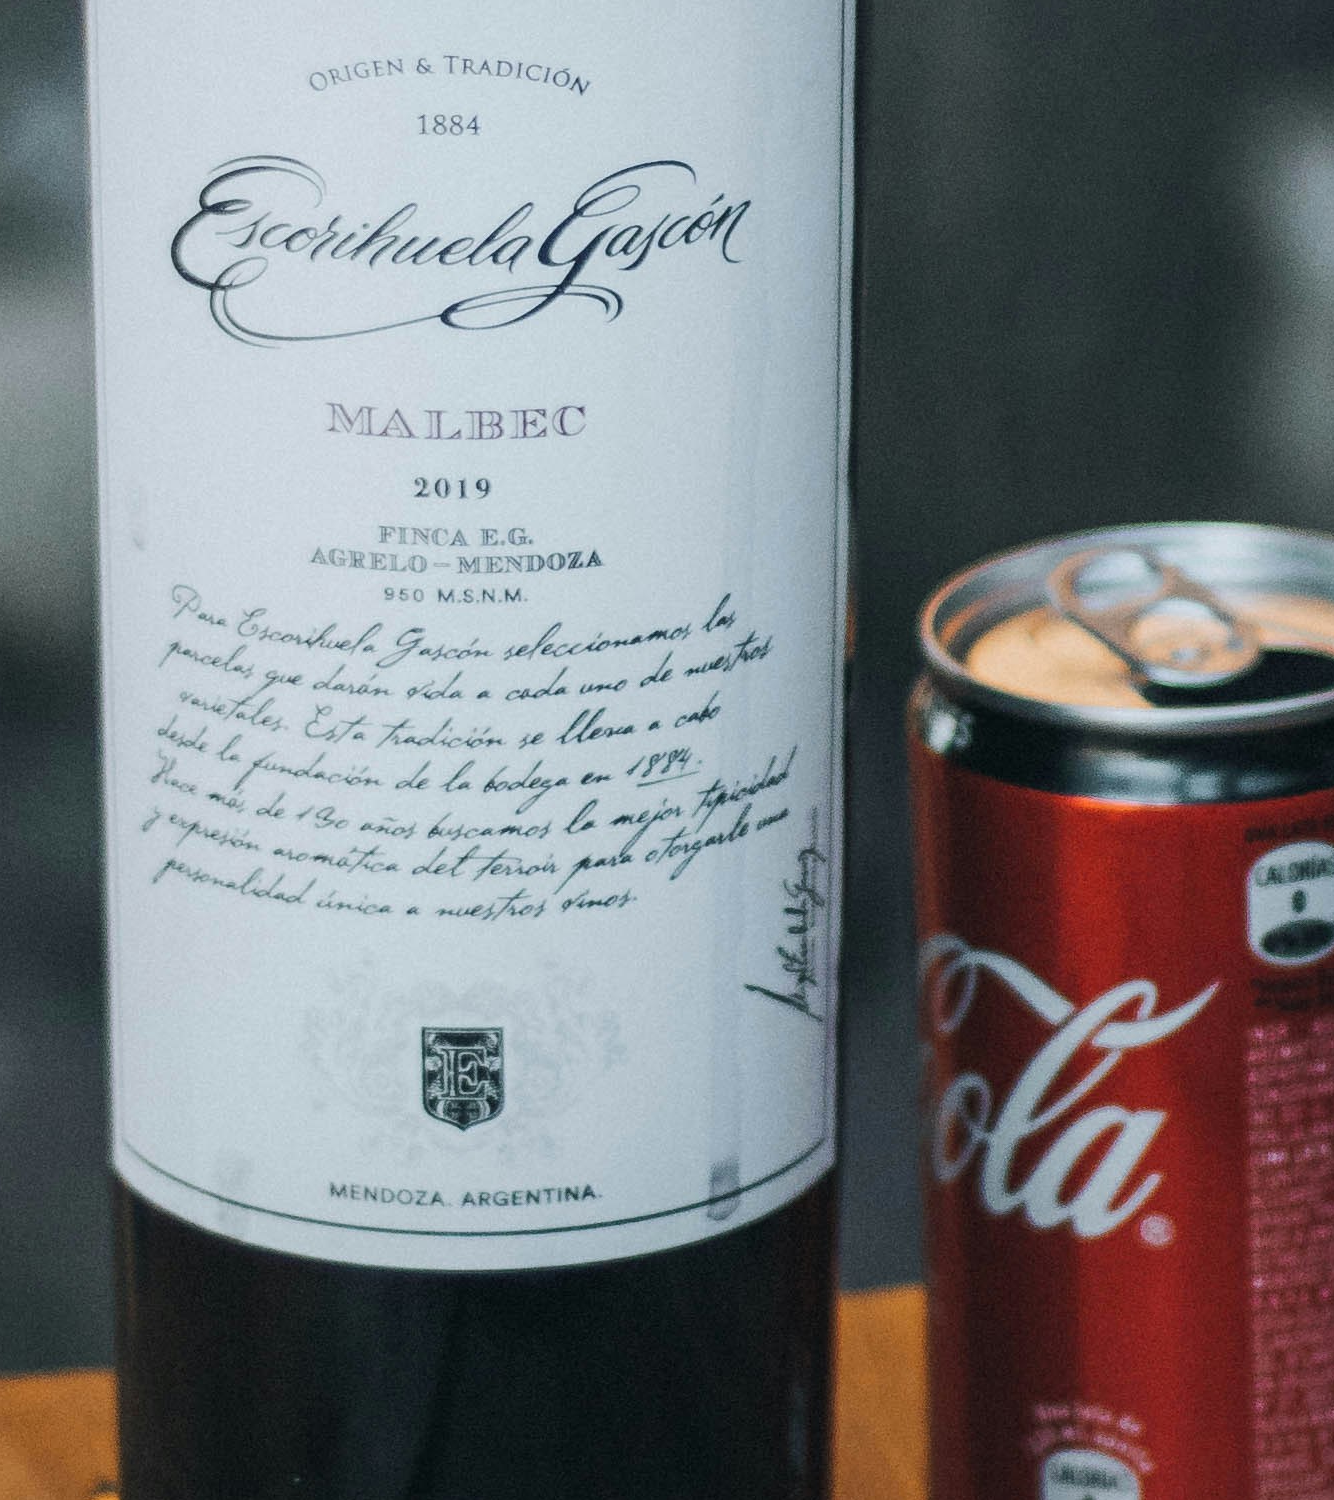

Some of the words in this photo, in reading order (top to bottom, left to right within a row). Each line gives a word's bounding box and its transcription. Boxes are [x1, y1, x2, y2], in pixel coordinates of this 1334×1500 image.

[309, 57, 404, 93] ORIGEN
[416, 57, 433, 75] &
[443, 54, 591, 96] TRADICIÓN
[417, 114, 481, 136] 1884
[171, 155, 535, 349] Escorihuela
[439, 160, 752, 330] Gascón
[326, 402, 587, 440] MALBEC
[413, 477, 492, 500] 2019
[310, 547, 428, 574] AGRELO
[456, 550, 605, 575] MENDOZA
[378, 525, 471, 547] FINCA
[480, 527, 534, 546] E.G.
[384, 587, 424, 602] 950
[438, 588, 528, 603] M.S.N.M.
[172, 584, 227, 627] Para
[237, 607, 381, 656] Escorihuela
[375, 627, 492, 668] Gascón
[503, 621, 692, 660] seleccionamos
[701, 592, 737, 632] las
[158, 639, 255, 679] parcelas
[248, 669, 304, 699] que
[313, 664, 393, 697] darán
[407, 670, 463, 700] vida
[476, 689, 491, 700] a
[505, 666, 570, 701] cada
[579, 679, 628, 696] uno
[639, 651, 673, 689] de
[684, 630, 773, 673] nuestros
[304, 705, 374, 743] Esta
[375, 717, 506, 748] tradición
[518, 731, 544, 748] se
[647, 720, 662, 732] a
[674, 691, 721, 729] cabo
[157, 715, 208, 753] desde
[220, 735, 241, 762] la
[233, 751, 383, 791] fundación
[395, 761, 430, 790] de
[443, 759, 472, 792] la
[483, 760, 571, 816] bodega
[580, 771, 614, 785] en
[256, 792, 285, 819] de
[360, 816, 418, 839] años
[427, 812, 552, 841] buscamos
[567, 799, 597, 834] la
[609, 799, 685, 856] mejor
[169, 812, 261, 849] expresión
[272, 846, 400, 873] aromática
[554, 849, 635, 895] para
[152, 857, 315, 904] personalidad
[317, 890, 393, 915] única
[405, 906, 420, 916] a
[436, 888, 546, 921] nuestros
